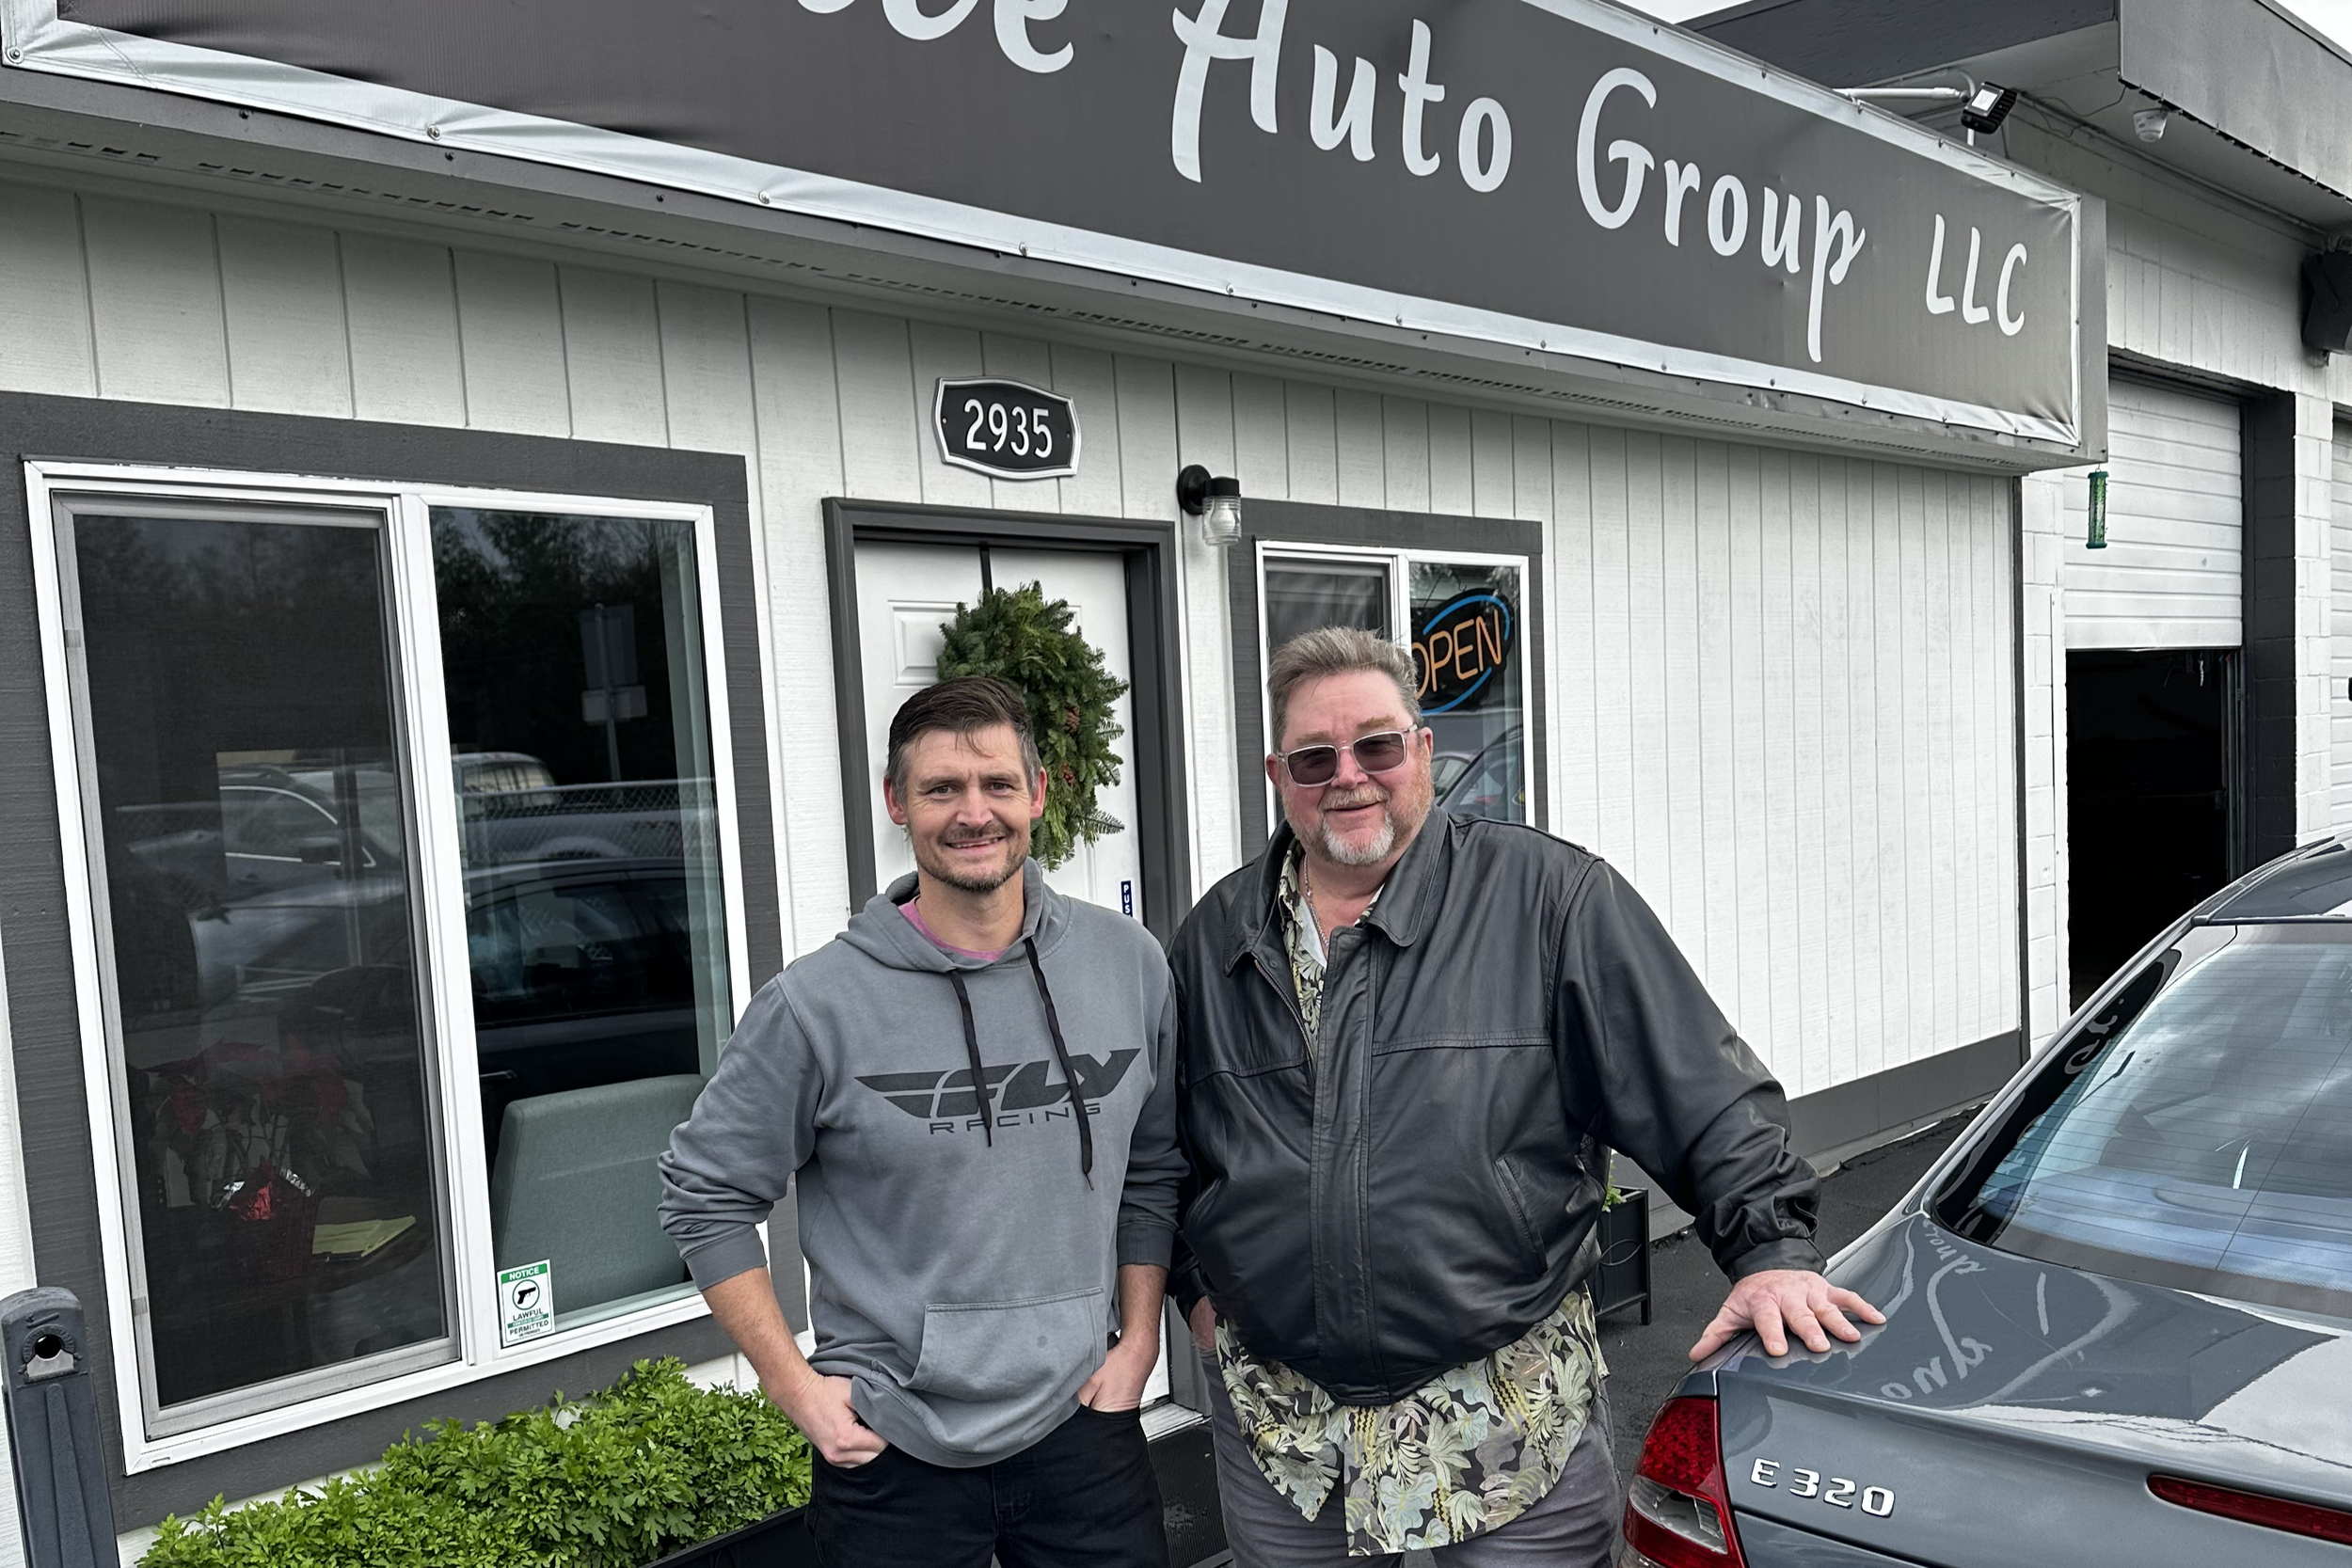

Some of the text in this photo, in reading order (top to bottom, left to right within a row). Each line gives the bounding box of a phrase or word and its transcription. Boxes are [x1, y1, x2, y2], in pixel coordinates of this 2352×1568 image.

[1172, 0, 2027, 363] Auto Group LLC
[963, 399, 1053, 458] 2935
[509, 1266, 539, 1280] NOTICE
[509, 1320, 548, 1336] PERMITTED
[513, 1307, 543, 1322] LAWFUL
[1751, 1458, 1896, 1518] E 320
